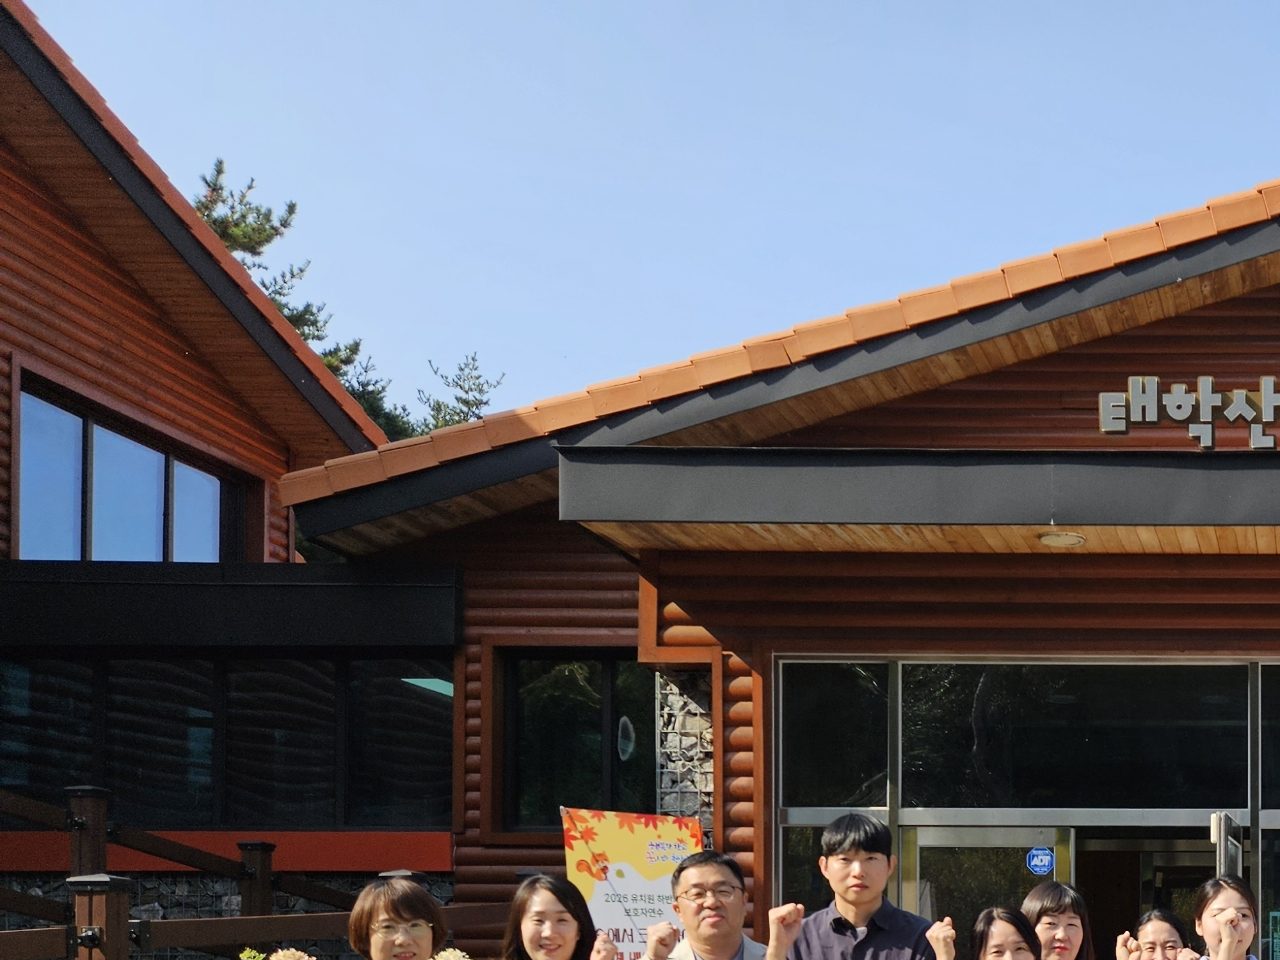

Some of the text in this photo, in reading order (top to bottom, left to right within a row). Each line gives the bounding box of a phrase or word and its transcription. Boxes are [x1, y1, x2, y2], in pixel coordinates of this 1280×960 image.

[1031, 855, 1051, 866] ADT
[630, 894, 656, 905] 유치원
[657, 894, 673, 905] 하반
[624, 908, 664, 918] 보호자연수
[596, 928, 634, 943] 에서
